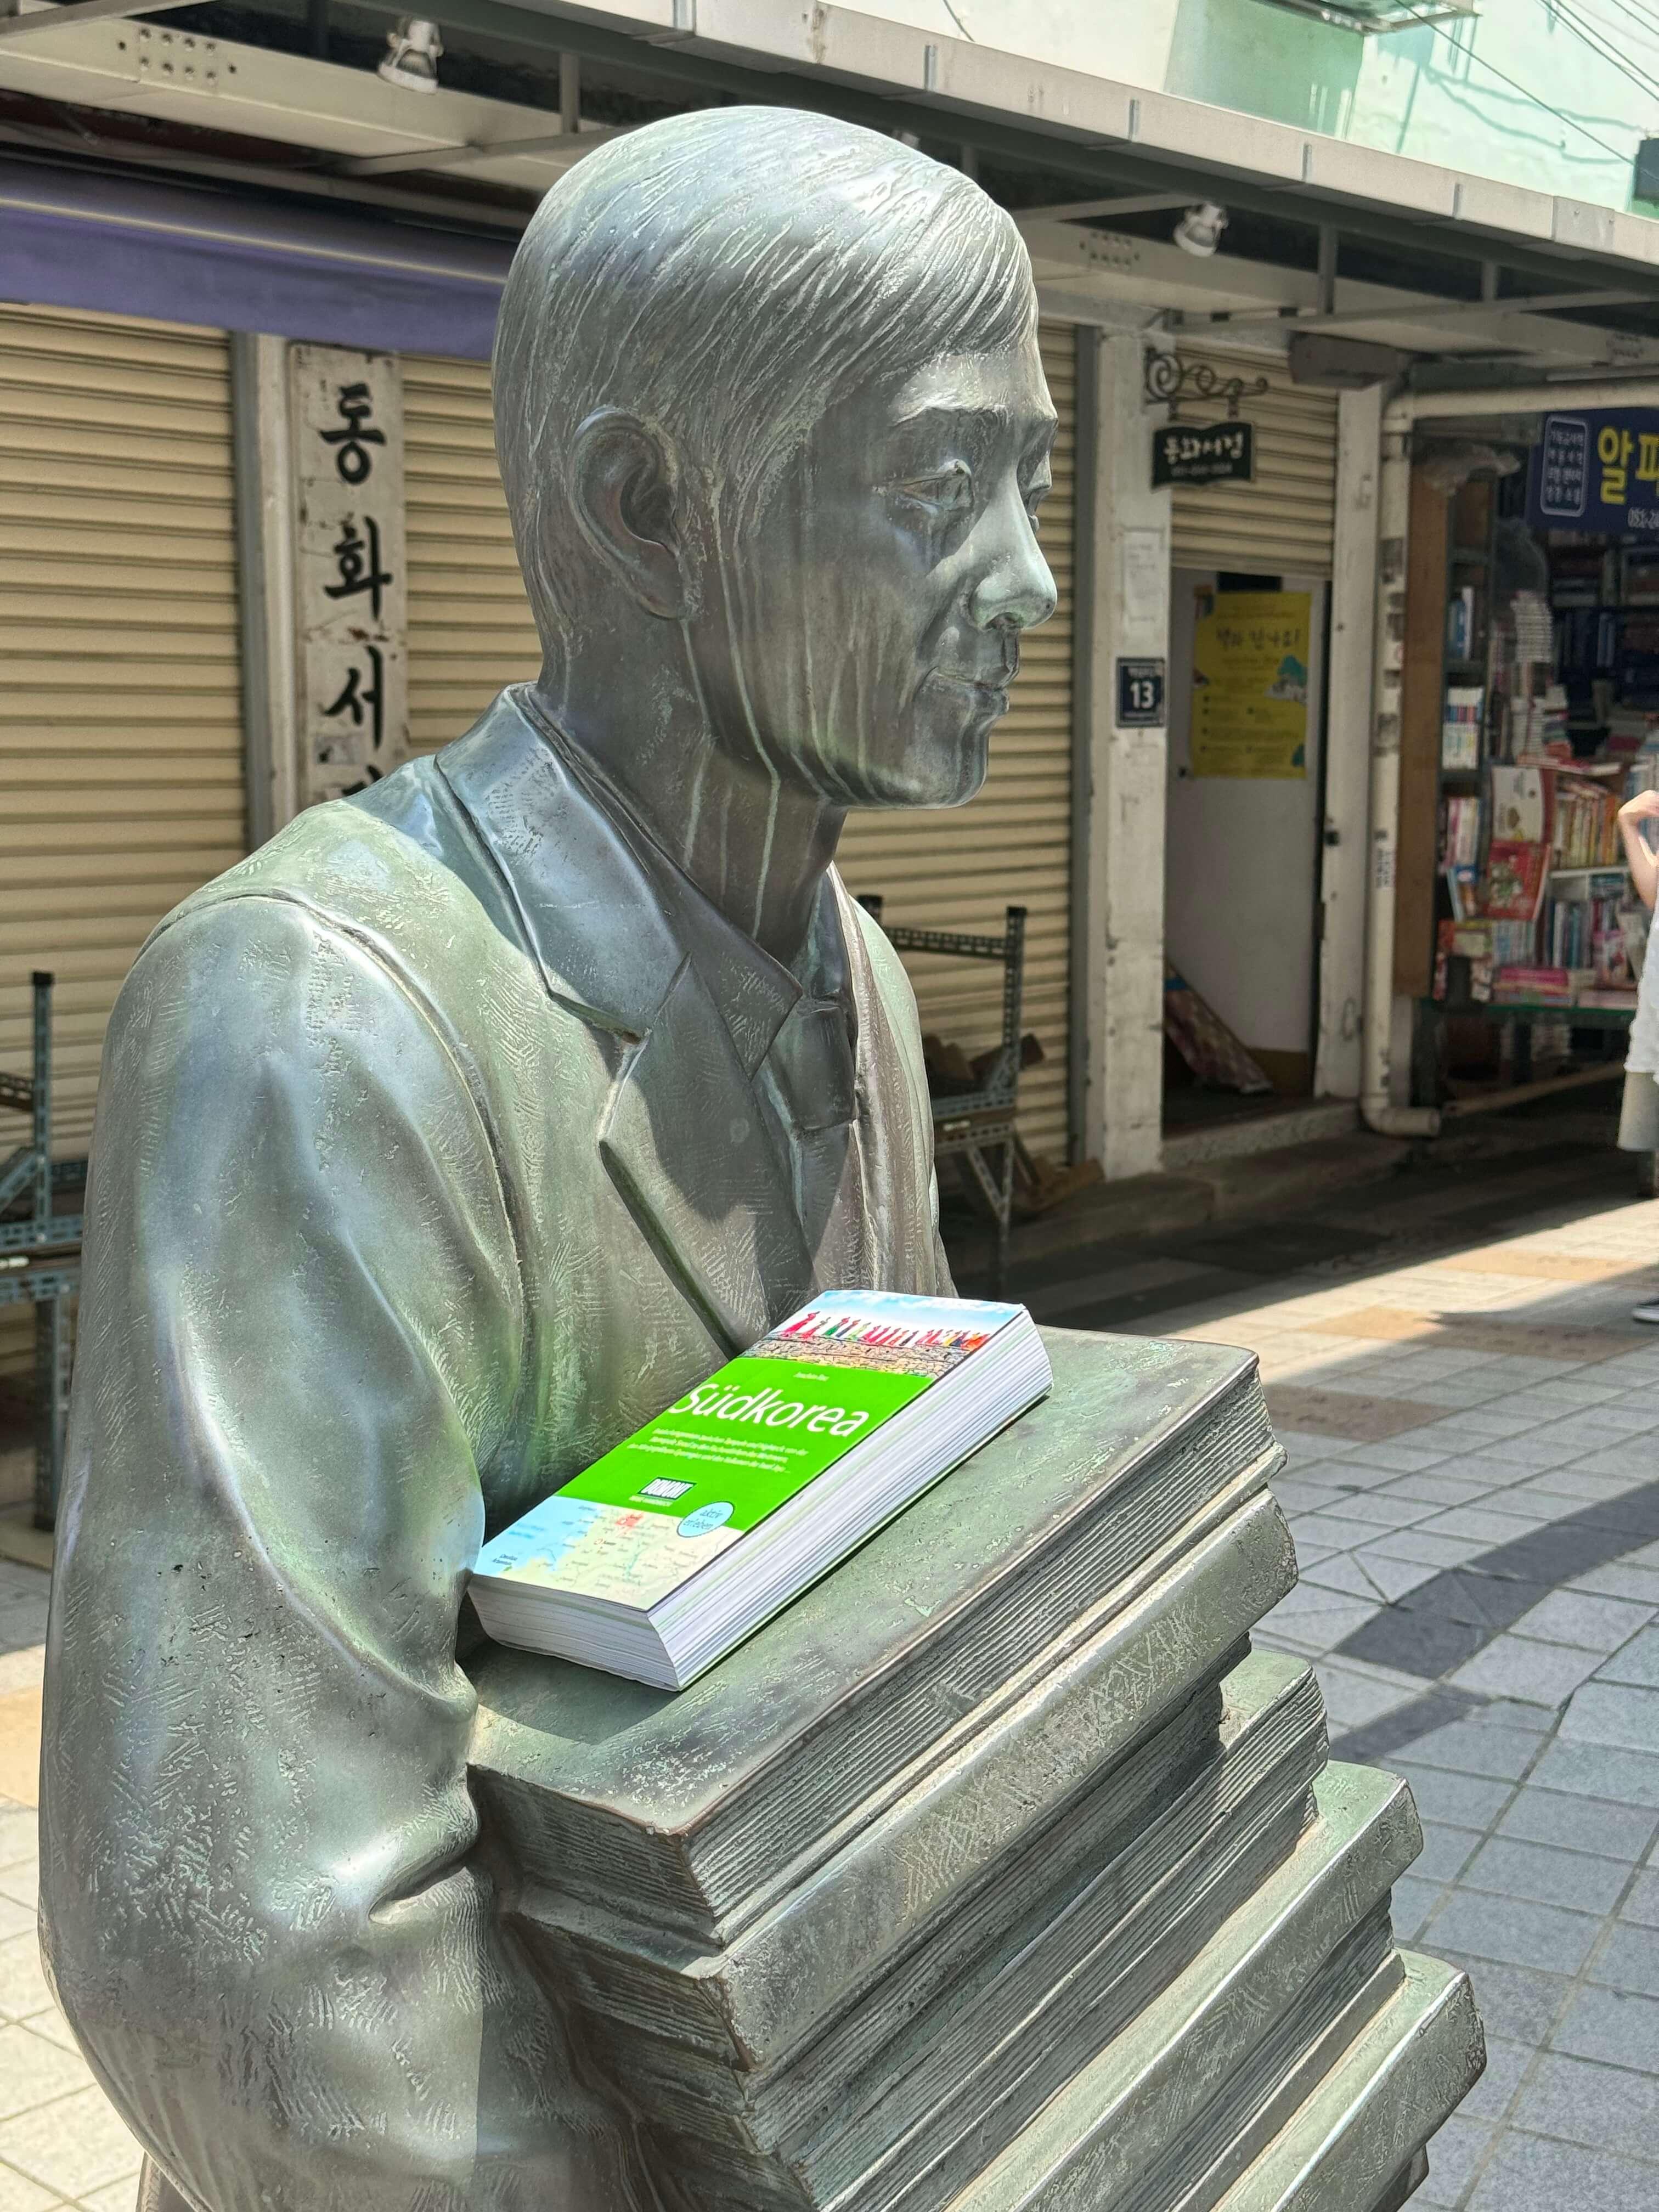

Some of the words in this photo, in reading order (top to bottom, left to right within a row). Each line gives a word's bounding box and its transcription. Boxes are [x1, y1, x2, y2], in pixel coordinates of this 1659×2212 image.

[319, 383, 394, 797] 동화서
[1130, 681, 1154, 709] 13
[667, 1384, 869, 1437] Südkorea
[640, 1478, 695, 1499] DUMONT
